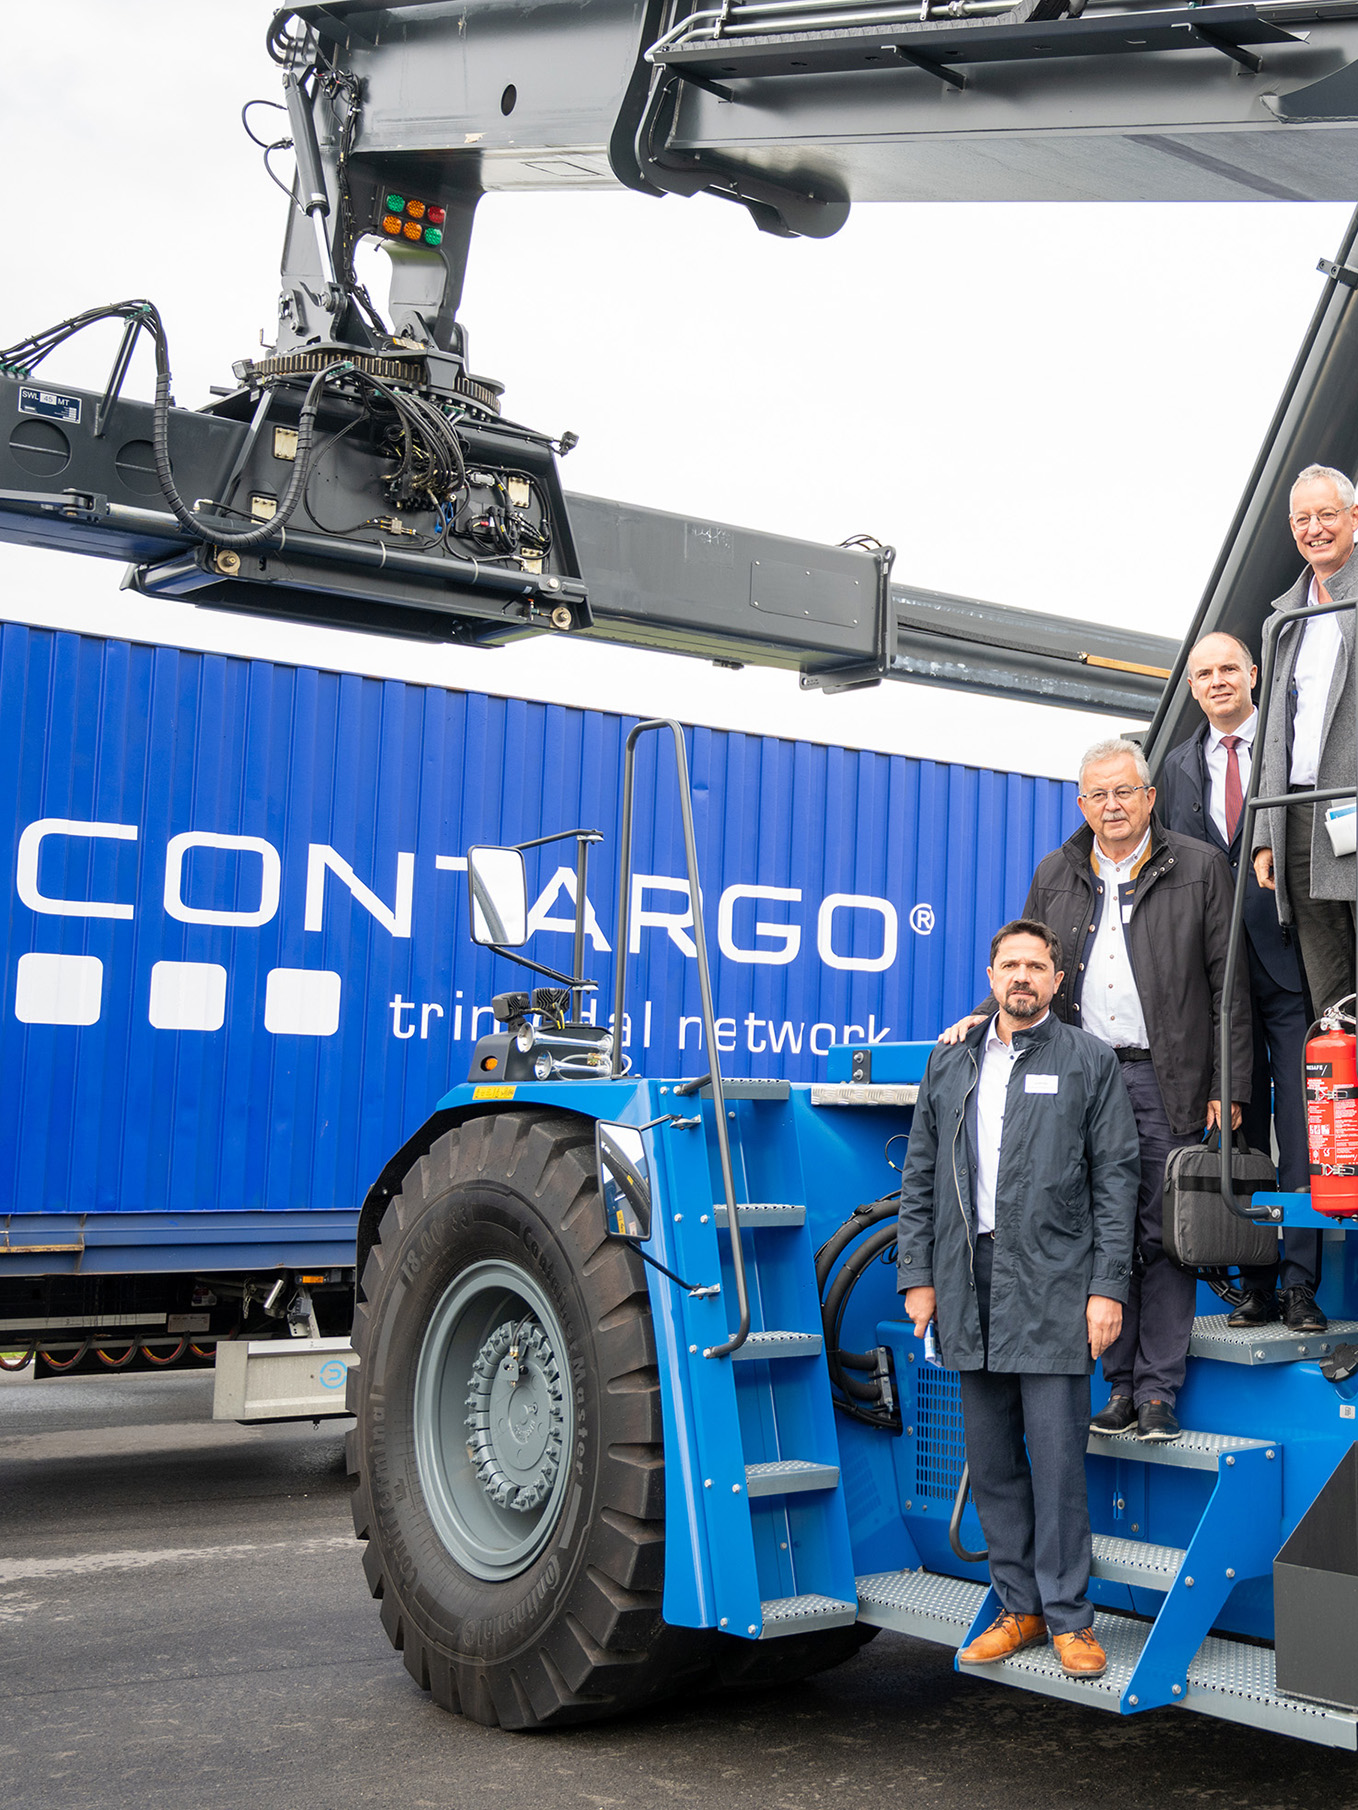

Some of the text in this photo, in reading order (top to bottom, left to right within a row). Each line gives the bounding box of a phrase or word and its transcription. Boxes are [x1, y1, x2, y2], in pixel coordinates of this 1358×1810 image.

[22, 390, 70, 406] SWL 45 MT
[679, 1012, 891, 1056] network
